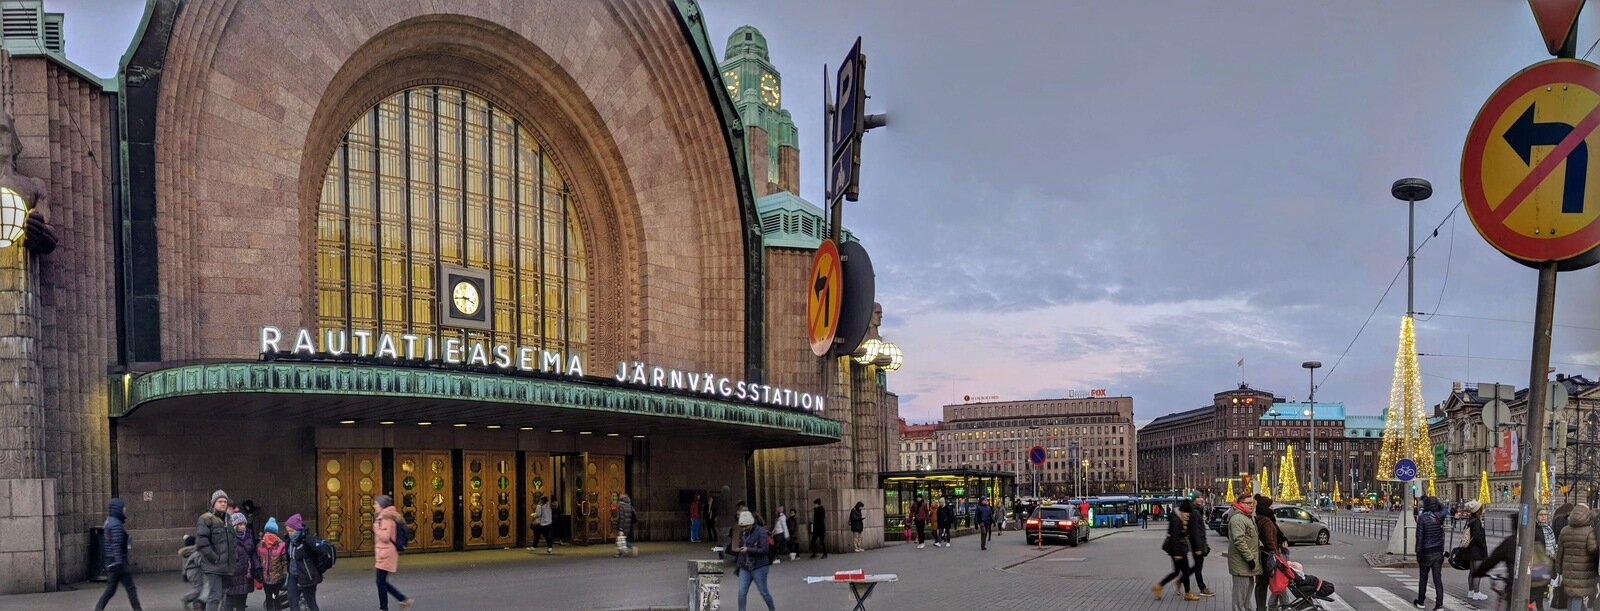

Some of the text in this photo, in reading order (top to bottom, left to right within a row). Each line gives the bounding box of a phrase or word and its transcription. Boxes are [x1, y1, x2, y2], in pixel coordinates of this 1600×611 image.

[836, 59, 853, 143] P
[261, 326, 584, 377] RAUTATIEASEMA
[615, 361, 825, 411] JÄRNVÄGSSTATION
